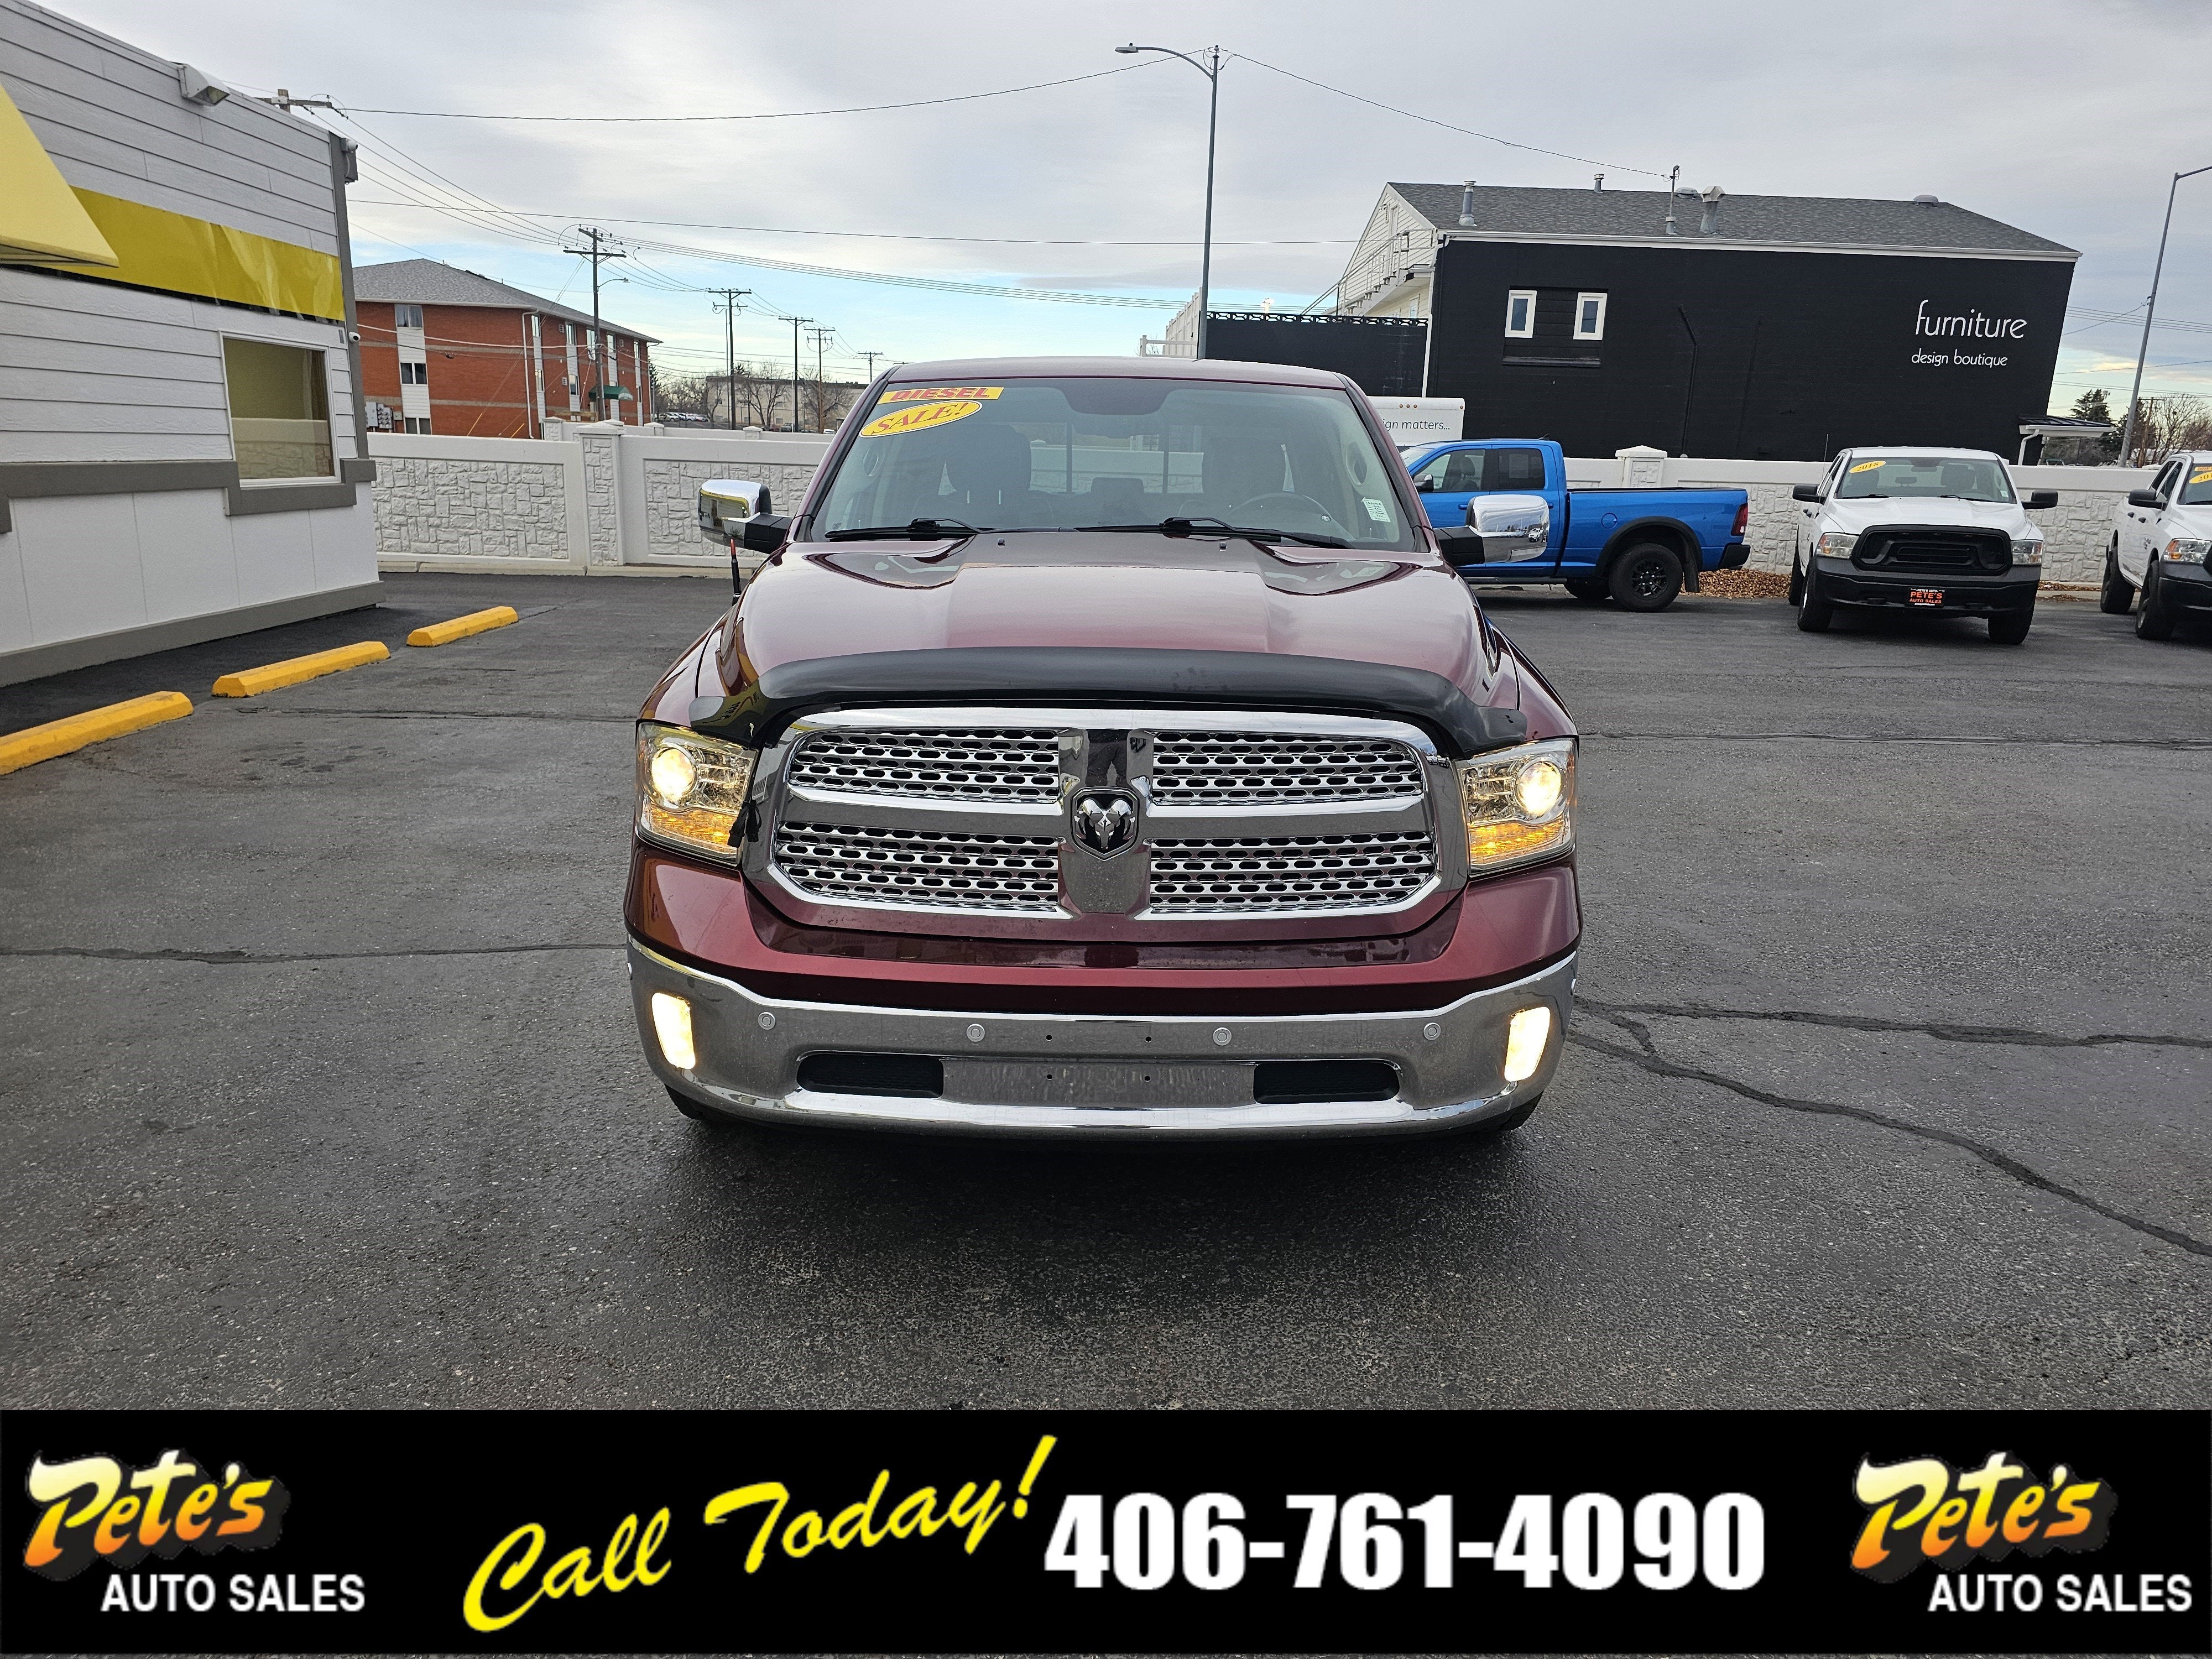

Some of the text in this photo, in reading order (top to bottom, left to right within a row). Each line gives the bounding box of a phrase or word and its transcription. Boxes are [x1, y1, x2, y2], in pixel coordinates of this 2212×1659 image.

[1915, 299, 2027, 338] furniture
[1911, 347, 2008, 368] design boutique
[889, 388, 989, 401] DIESEL
[871, 403, 969, 435] SALE!
[1401, 420, 1451, 430] matters...
